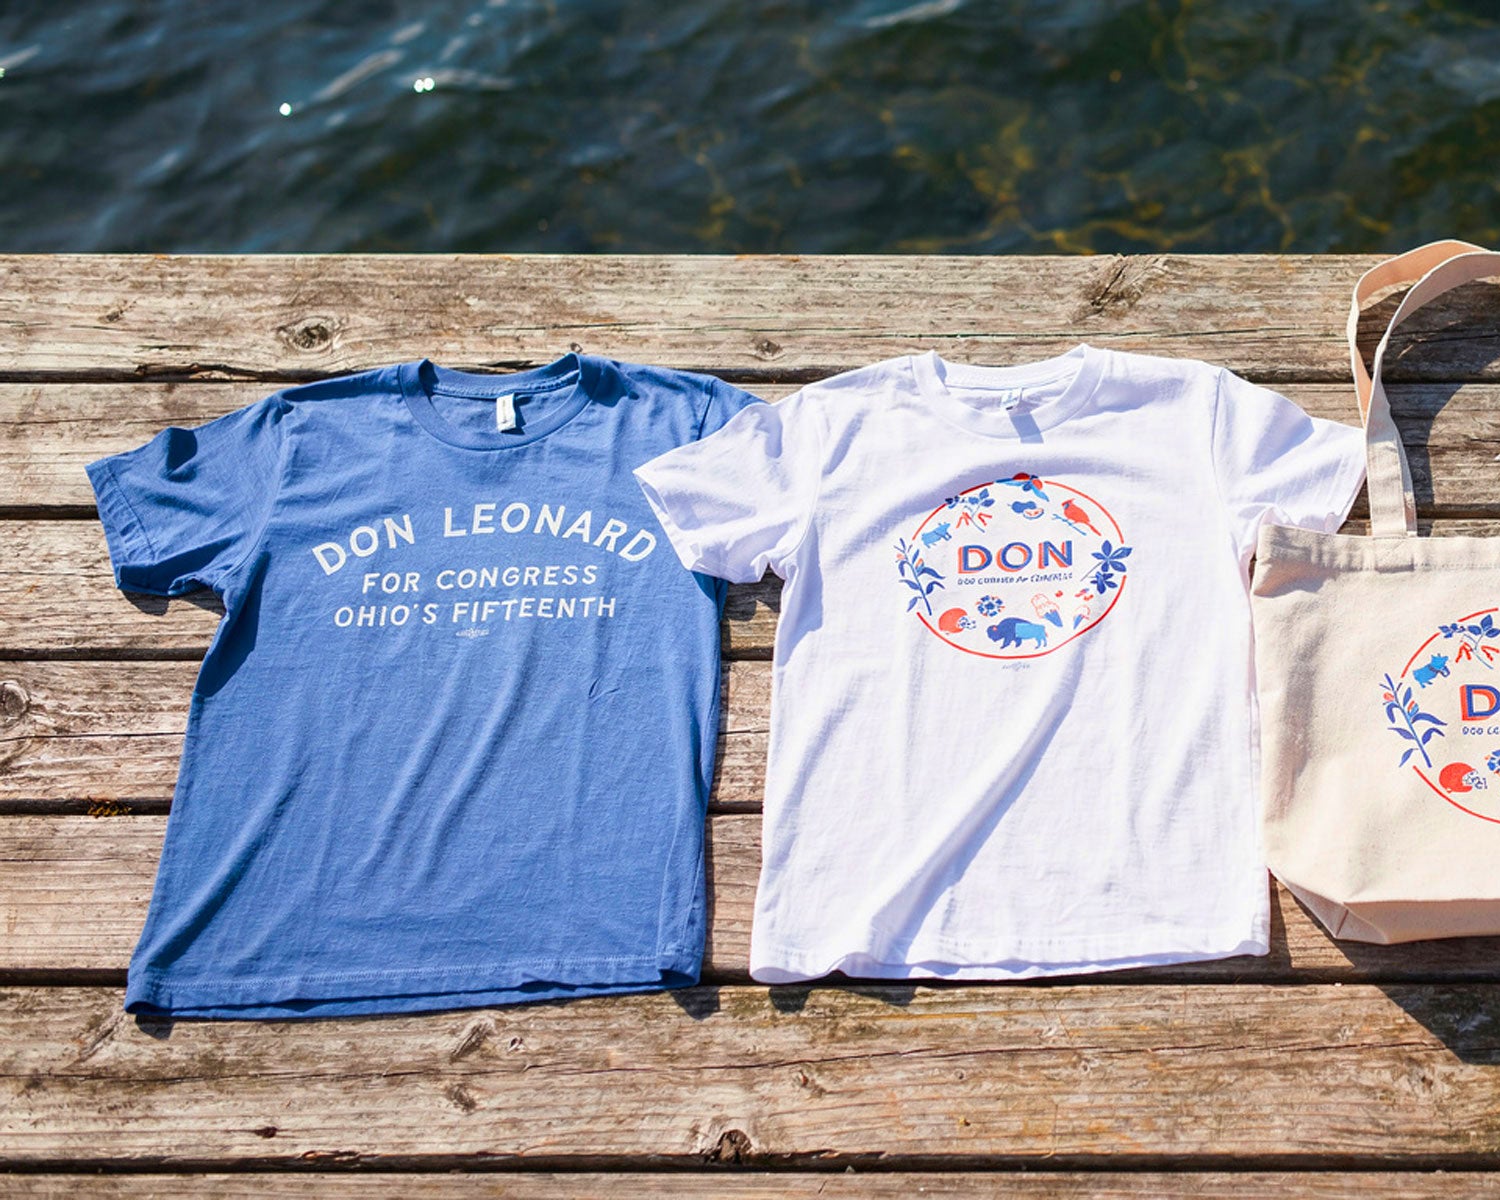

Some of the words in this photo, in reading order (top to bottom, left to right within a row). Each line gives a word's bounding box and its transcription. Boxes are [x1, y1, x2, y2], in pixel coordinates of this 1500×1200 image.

[313, 514, 415, 575] DON
[443, 503, 657, 562] LEONARD
[957, 540, 1073, 574] DON
[362, 572, 420, 594] FOR
[436, 565, 598, 591] CONGRESS
[334, 603, 439, 628] OHIO'S
[452, 597, 616, 623] FIFTEENTH
